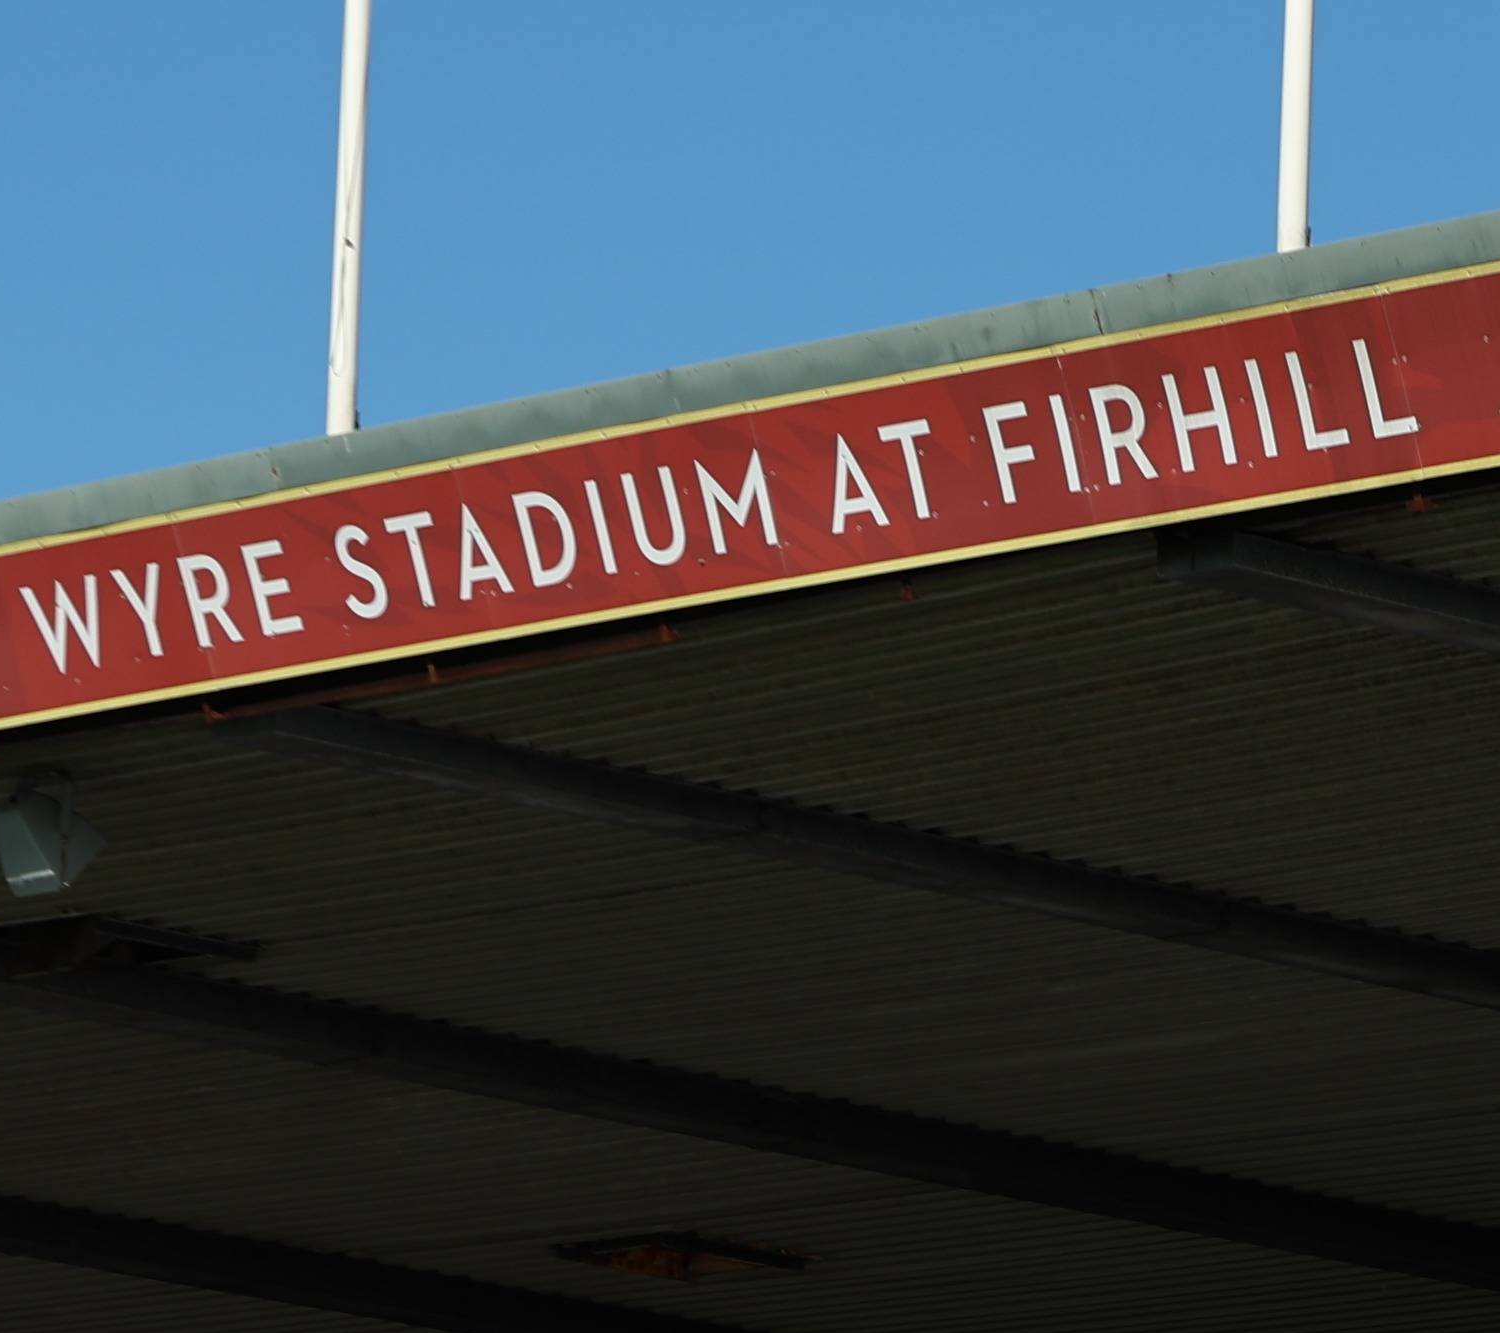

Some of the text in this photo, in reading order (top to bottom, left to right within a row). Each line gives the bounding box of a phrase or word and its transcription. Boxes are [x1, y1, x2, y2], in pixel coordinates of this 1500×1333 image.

[18, 540, 304, 674] WYRE
[343, 447, 779, 620] STADIUM
[831, 418, 932, 535] AT
[982, 338, 1419, 505] FIRHILL
